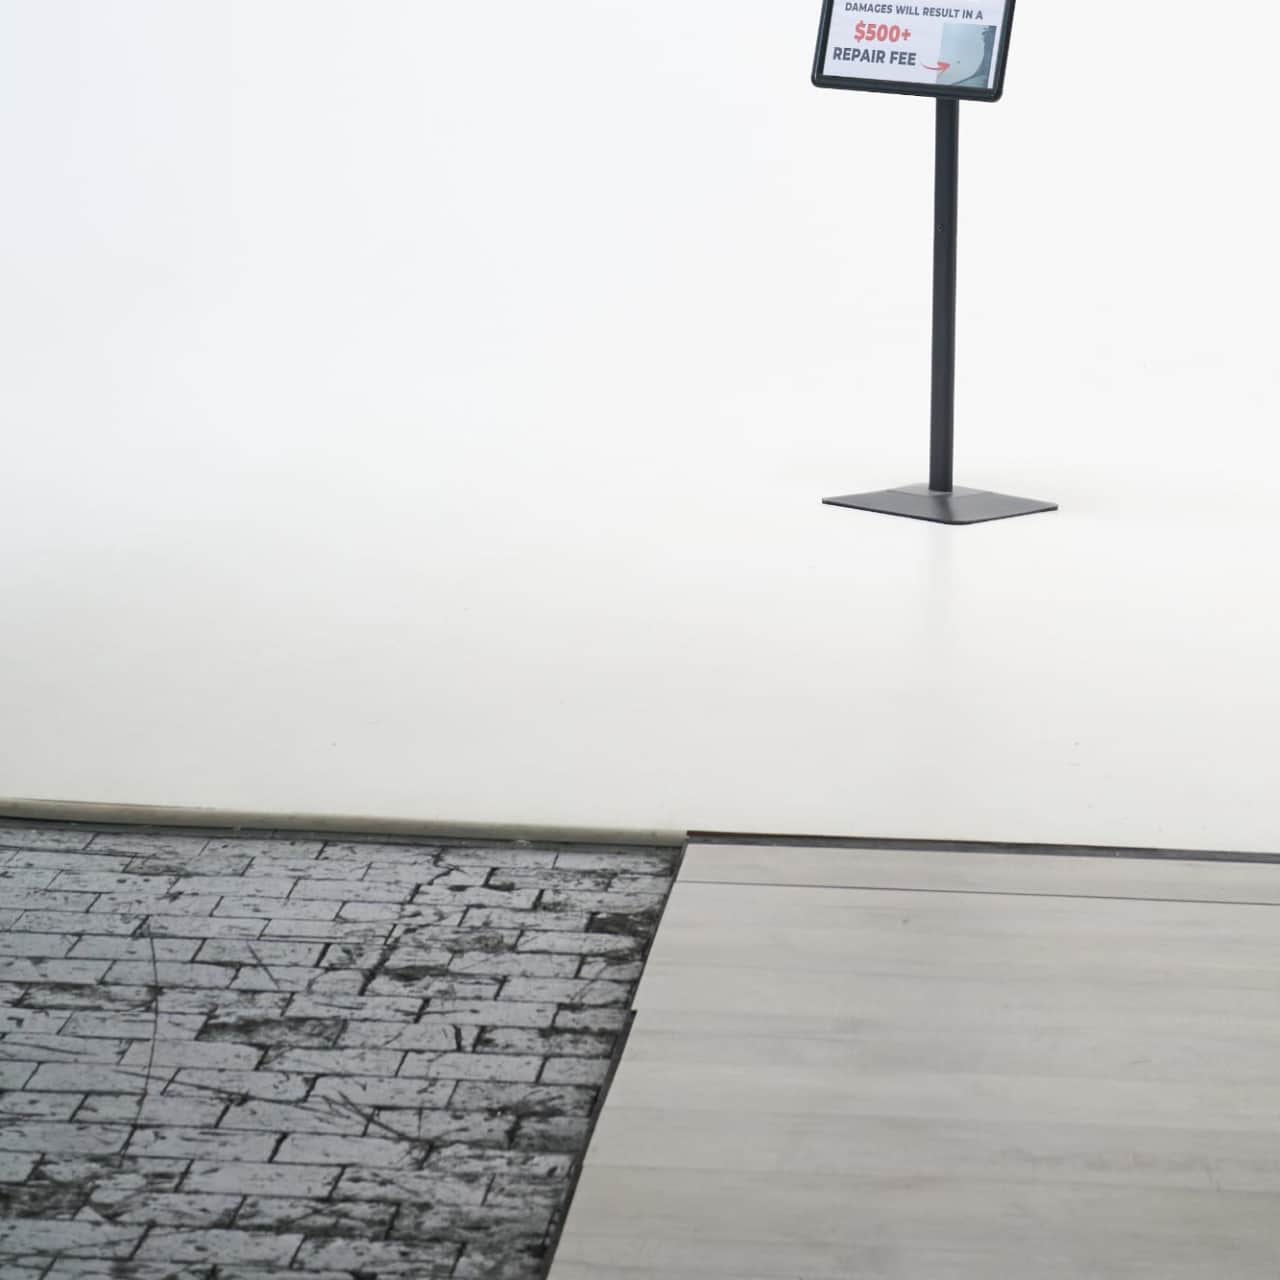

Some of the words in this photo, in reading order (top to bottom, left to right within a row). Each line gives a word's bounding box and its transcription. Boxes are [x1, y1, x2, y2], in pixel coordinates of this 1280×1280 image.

[844, 2, 893, 14] DAMAGES
[895, 5, 920, 16] WILL
[922, 6, 960, 18] RESULT
[962, 9, 973, 19] IN
[974, 10, 984, 20] A
[854, 20, 911, 43] $500+
[832, 46, 888, 64] REPAIR
[890, 51, 917, 66] FEE
